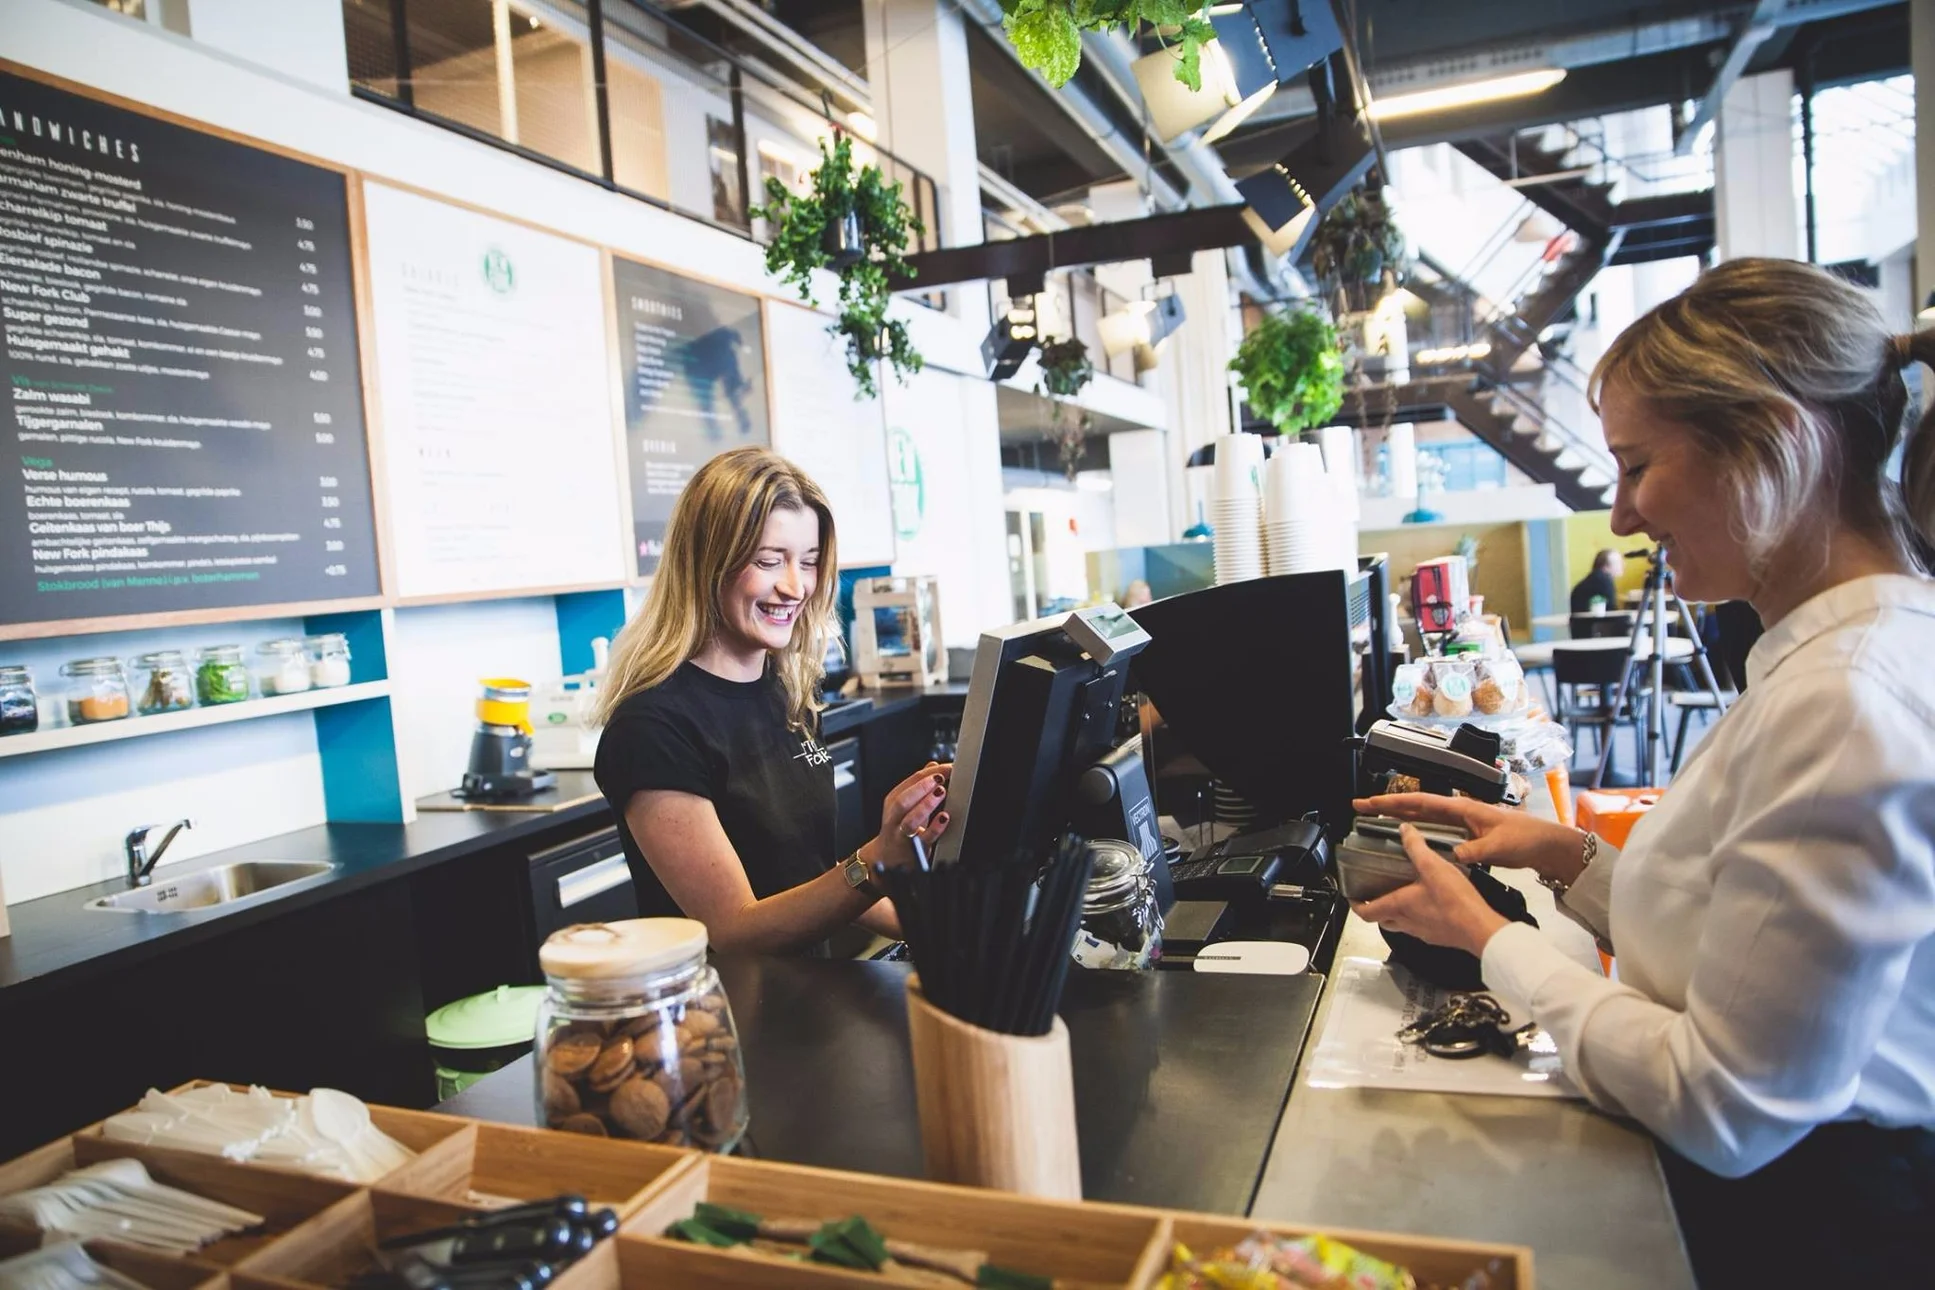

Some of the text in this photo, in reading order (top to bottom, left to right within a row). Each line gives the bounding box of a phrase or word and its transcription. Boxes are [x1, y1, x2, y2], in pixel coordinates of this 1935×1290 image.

[64, 214, 107, 232] tomaat
[0, 226, 93, 254] osbief spinazie
[64, 264, 101, 280] bacon
[0, 280, 91, 303] New Fork Club
[3, 308, 88, 329] Super gezond
[7, 336, 130, 359] Huisgemaakt gehakt
[13, 389, 91, 405] Zalm wasabi
[16, 416, 104, 431] Tijgergarnalen
[22, 469, 108, 482] Verse humous
[26, 496, 131, 507] Echte boerenkaas
[29, 523, 97, 534] Geitenkaas
[97, 523, 118, 533] van
[118, 523, 145, 533] boer
[33, 547, 149, 560] New Fork pindakaas
